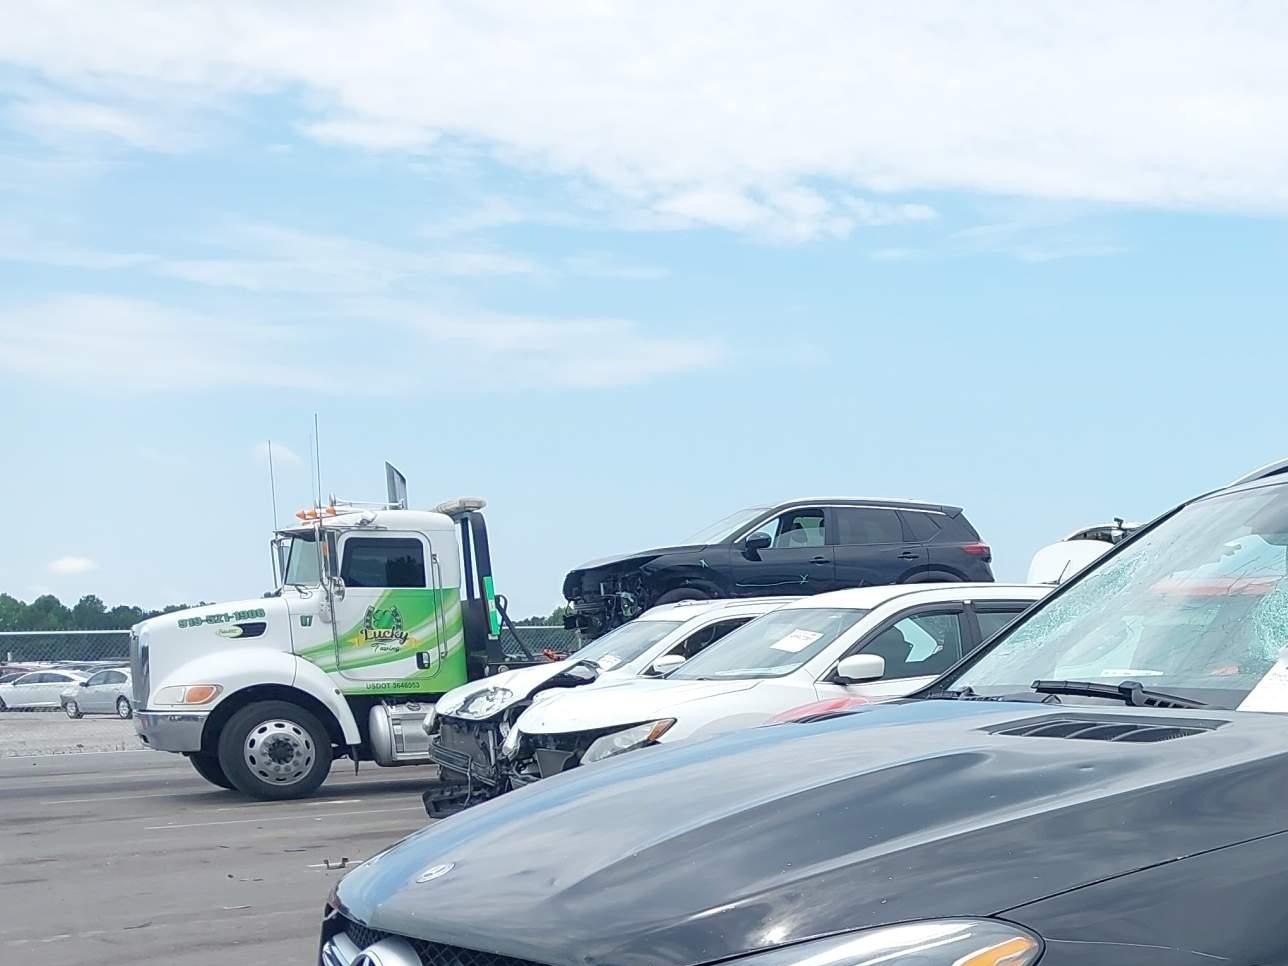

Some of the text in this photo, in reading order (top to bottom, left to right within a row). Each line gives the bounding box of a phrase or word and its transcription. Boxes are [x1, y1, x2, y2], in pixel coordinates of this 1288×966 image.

[360, 626, 408, 645] Lucky
[370, 642, 400, 652] Towing
[366, 682, 391, 690] USDOT
